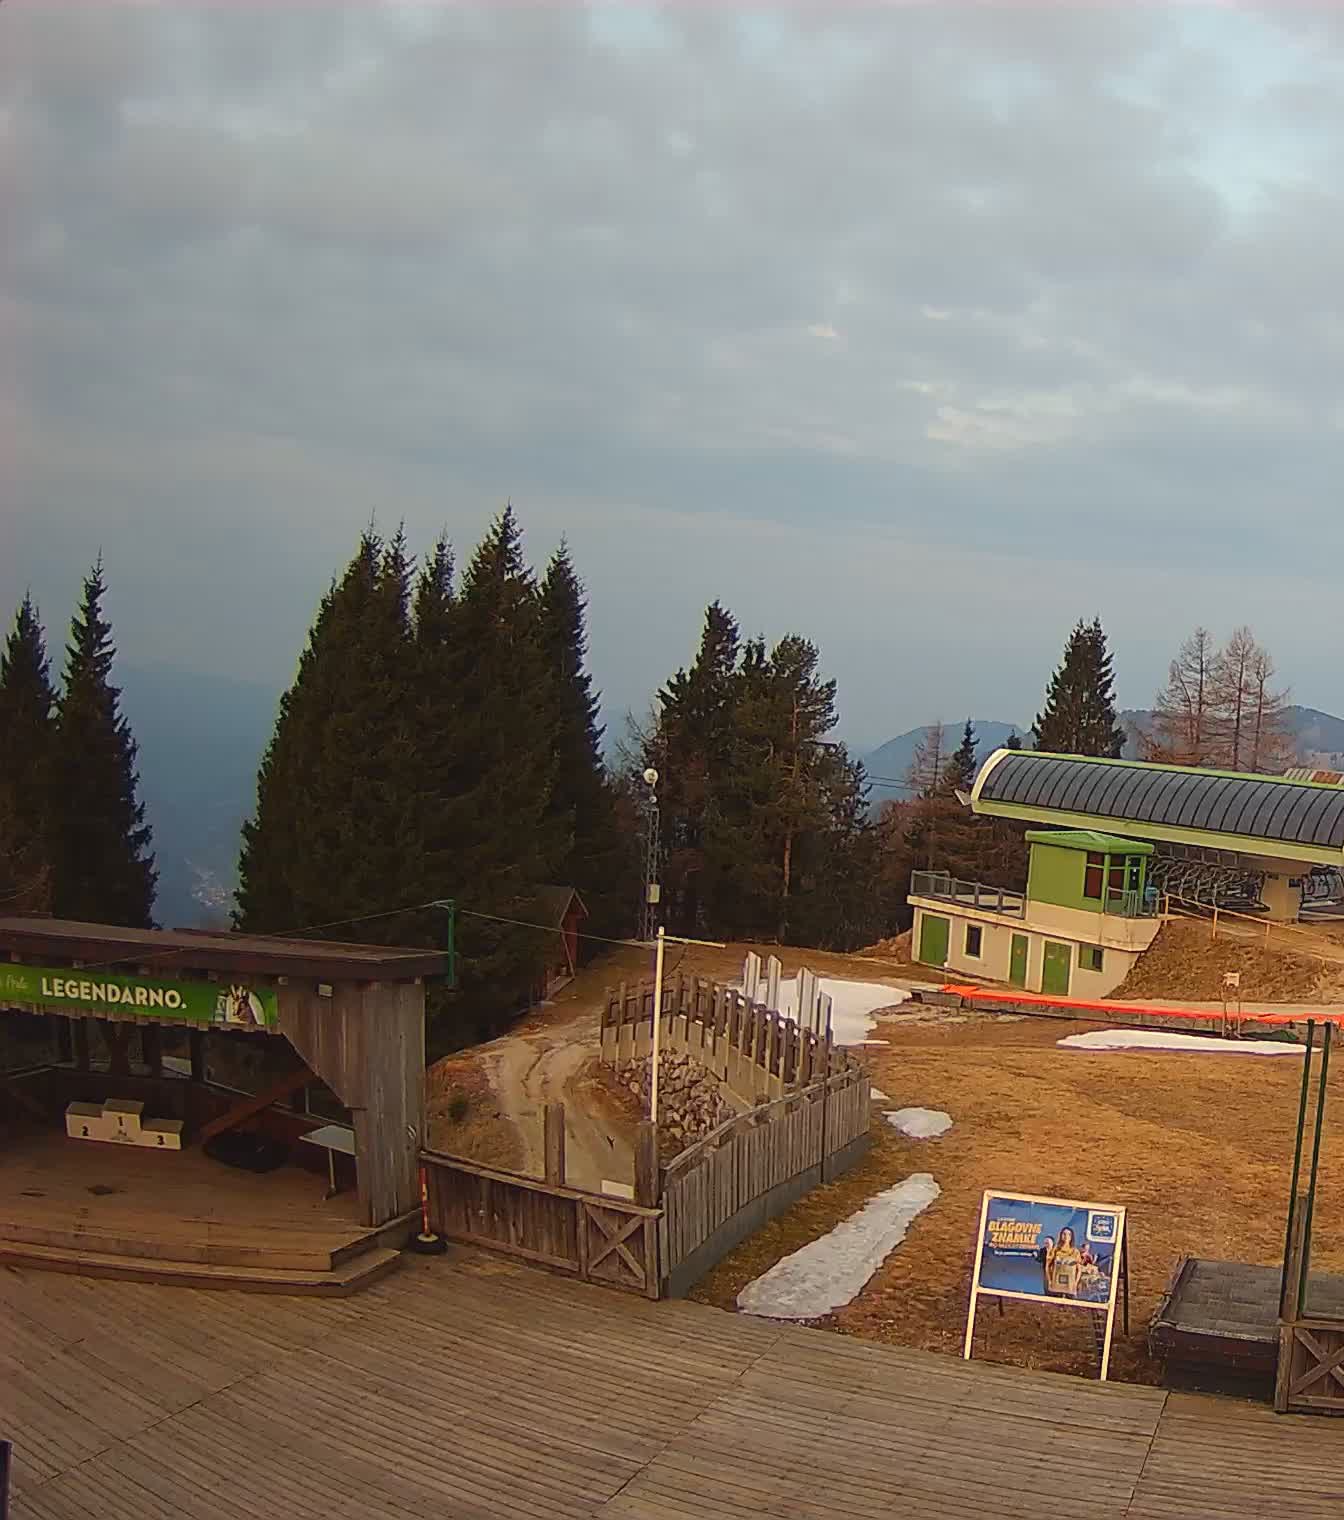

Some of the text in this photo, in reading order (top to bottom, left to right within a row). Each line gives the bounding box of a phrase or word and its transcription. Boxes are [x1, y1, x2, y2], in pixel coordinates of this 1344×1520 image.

[41, 976, 188, 1009] LEGENDARNO.
[118, 1116, 124, 1127] 1
[82, 1126, 89, 1136] 2
[157, 1135, 165, 1145] 3
